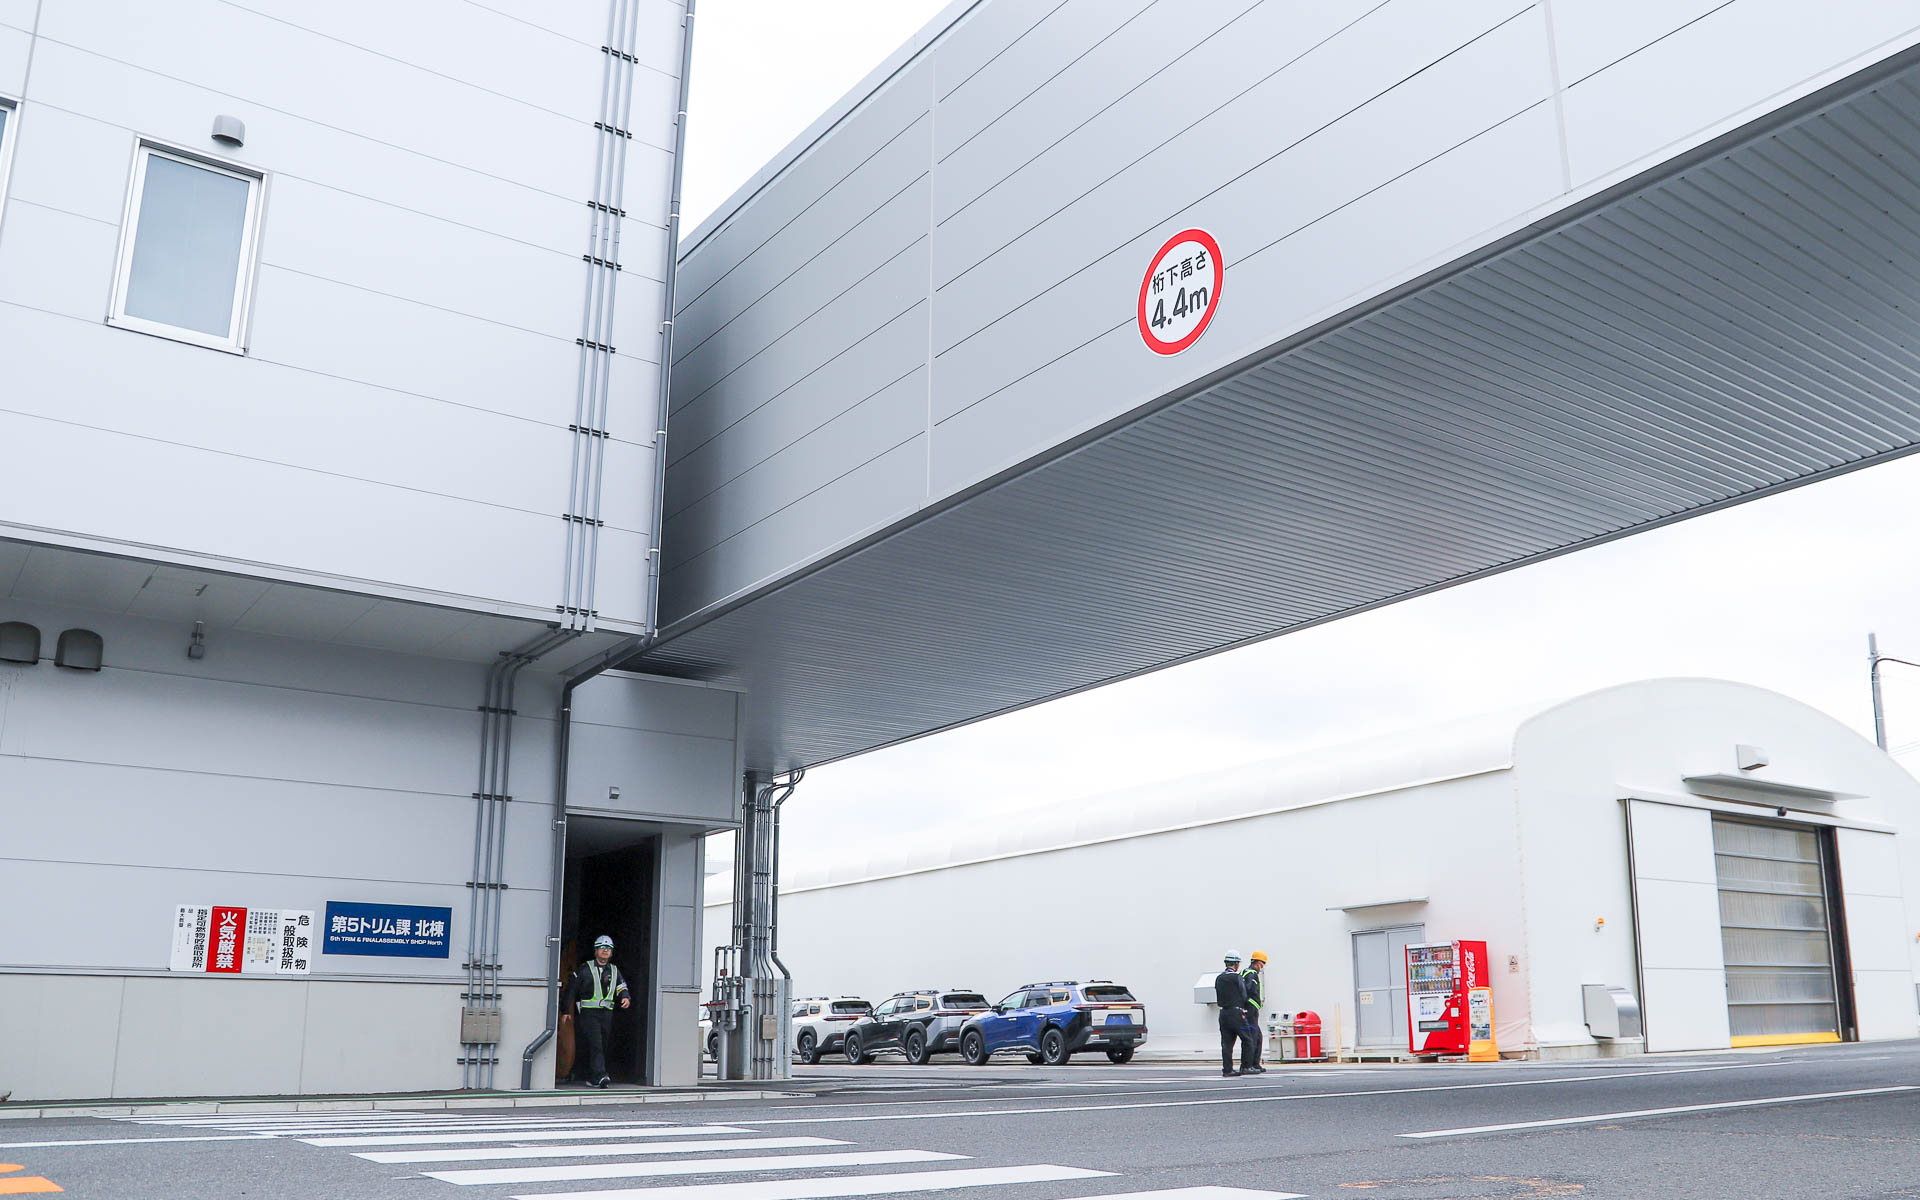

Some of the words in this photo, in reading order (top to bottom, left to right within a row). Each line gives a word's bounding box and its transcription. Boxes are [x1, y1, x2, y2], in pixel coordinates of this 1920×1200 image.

[1152, 250, 1207, 295] 桁下高さ
[1151, 286, 1208, 329] 4.4m
[216, 911, 238, 969] 火気厳禁
[281, 917, 297, 970] 一般取扱所
[295, 914, 310, 970] 危険物
[331, 915, 411, 936] 第5トリム課
[415, 919, 445, 937] 北棟
